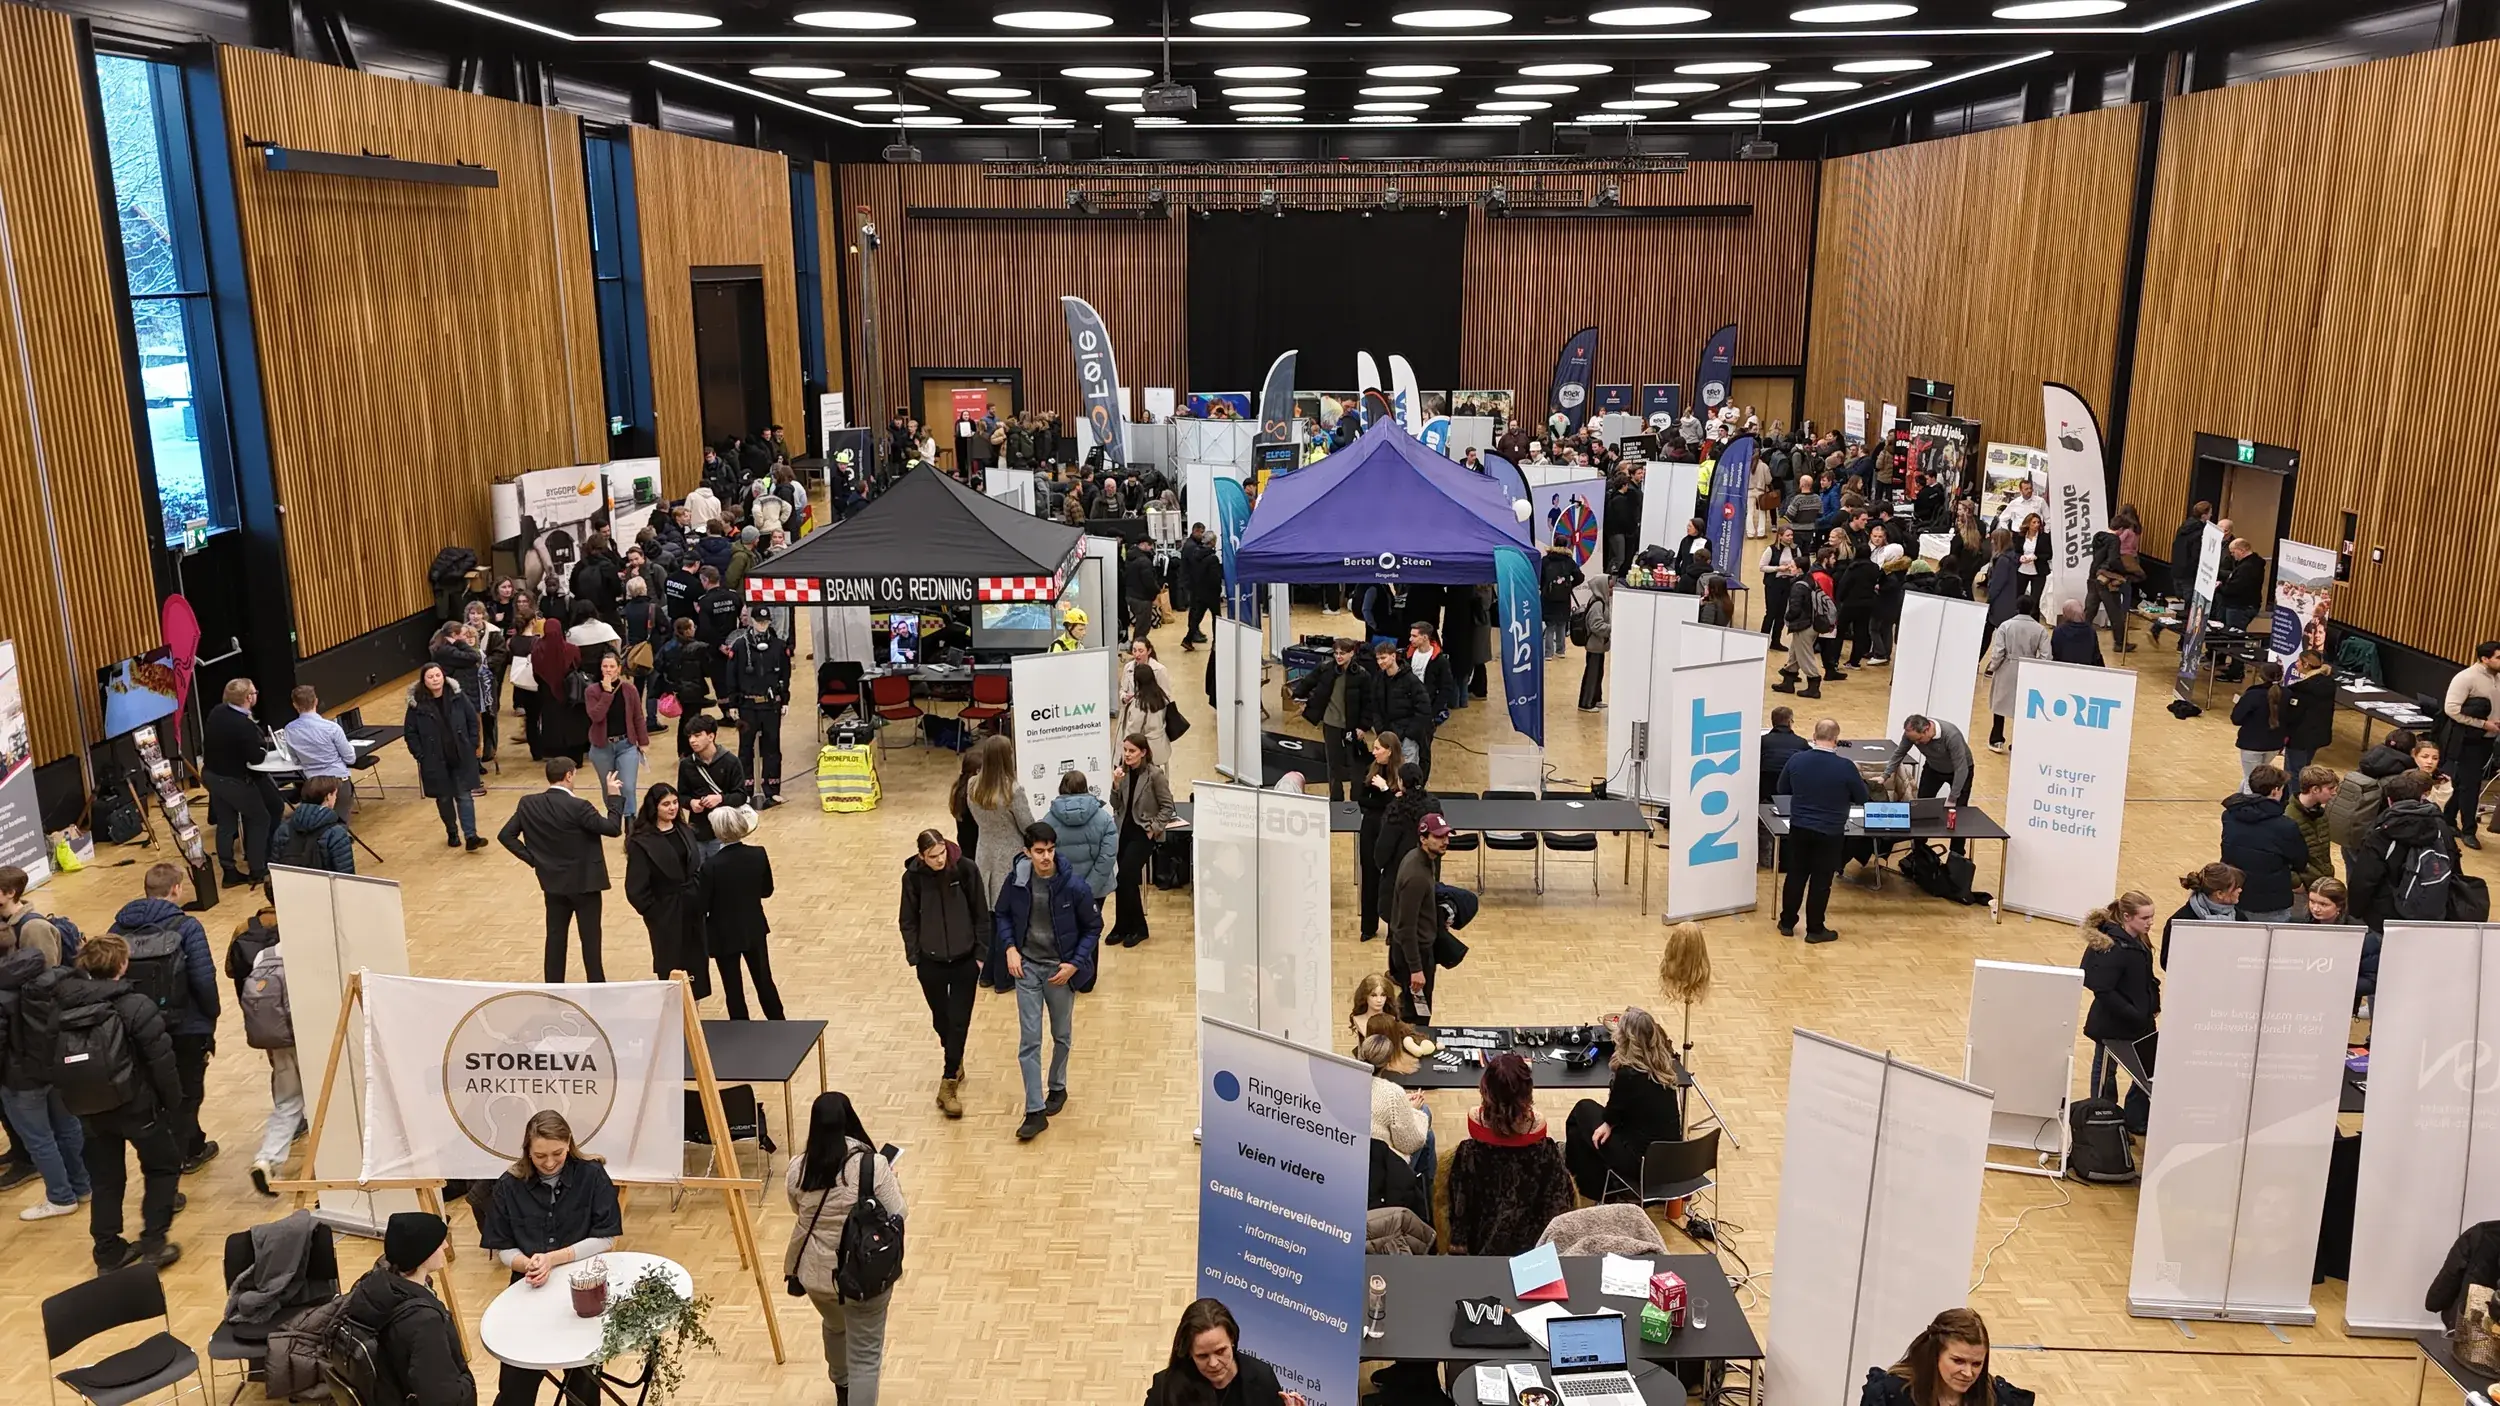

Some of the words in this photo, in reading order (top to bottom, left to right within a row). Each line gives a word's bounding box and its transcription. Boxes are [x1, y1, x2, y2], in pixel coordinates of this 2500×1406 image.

[1931, 424, 1942, 436] til
[1942, 424, 1949, 437] å
[546, 485, 576, 496] BYGGOPP
[1718, 520, 1727, 567] pareBank
[1344, 557, 1375, 566] Bertel
[1402, 557, 1431, 566] Steen
[826, 578, 875, 601] BRANN
[881, 577, 903, 600] OG
[910, 577, 972, 600] REDNING
[1031, 704, 1060, 721] ecit
[1064, 703, 1096, 717] LAW
[1026, 729, 1038, 737] Din
[1039, 721, 1101, 736] forretningsadvokat
[2039, 764, 2052, 776] Vi
[2055, 768, 2096, 783] styrer
[2047, 783, 2067, 796] din
[2071, 786, 2084, 799] IT
[2033, 799, 2051, 812] Du
[2054, 804, 2095, 820] styrer
[2028, 816, 2048, 829] din
[2052, 819, 2096, 838] bedrift
[465, 1052, 597, 1072] STORELVA
[465, 1078, 599, 1095] ARKITEKTER
[1249, 1077, 1322, 1114] Ringerike
[1247, 1097, 1357, 1146] karrieresenter
[1238, 1141, 1276, 1167] Veien
[1280, 1159, 1325, 1184] videre
[1210, 1179, 1244, 1201] Gratis
[1246, 1191, 1353, 1244] karriereveiledning
[1245, 1223, 1307, 1256] informasjon
[1244, 1250, 1303, 1285] kartlegging
[1205, 1266, 1222, 1280] om
[1223, 1271, 1248, 1290] jobb
[1250, 1283, 1265, 1299] og
[1266, 1291, 1348, 1333] utdanningsvalg
[1306, 1379, 1321, 1392] på
